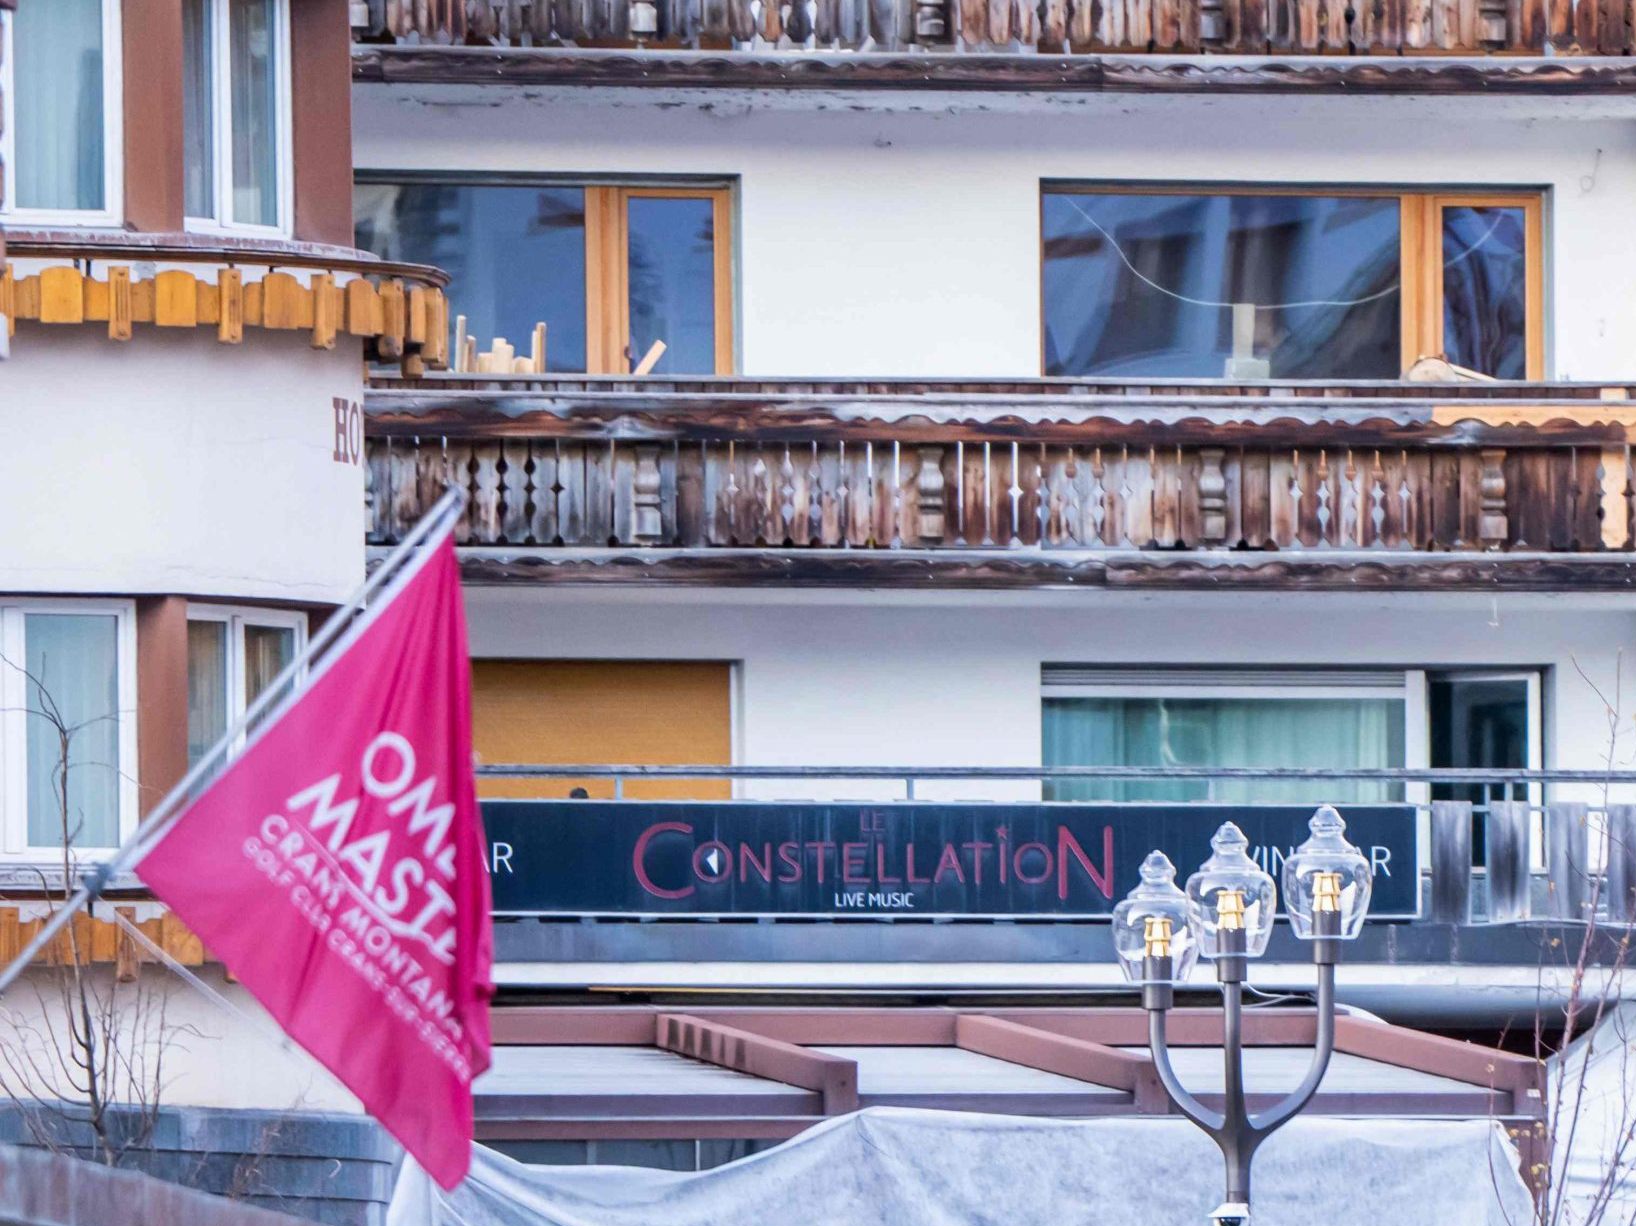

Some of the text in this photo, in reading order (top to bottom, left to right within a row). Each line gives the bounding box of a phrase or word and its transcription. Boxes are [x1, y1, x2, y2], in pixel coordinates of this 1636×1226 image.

[860, 810, 885, 832] LE
[835, 892, 915, 908] LIVE MUSIC
